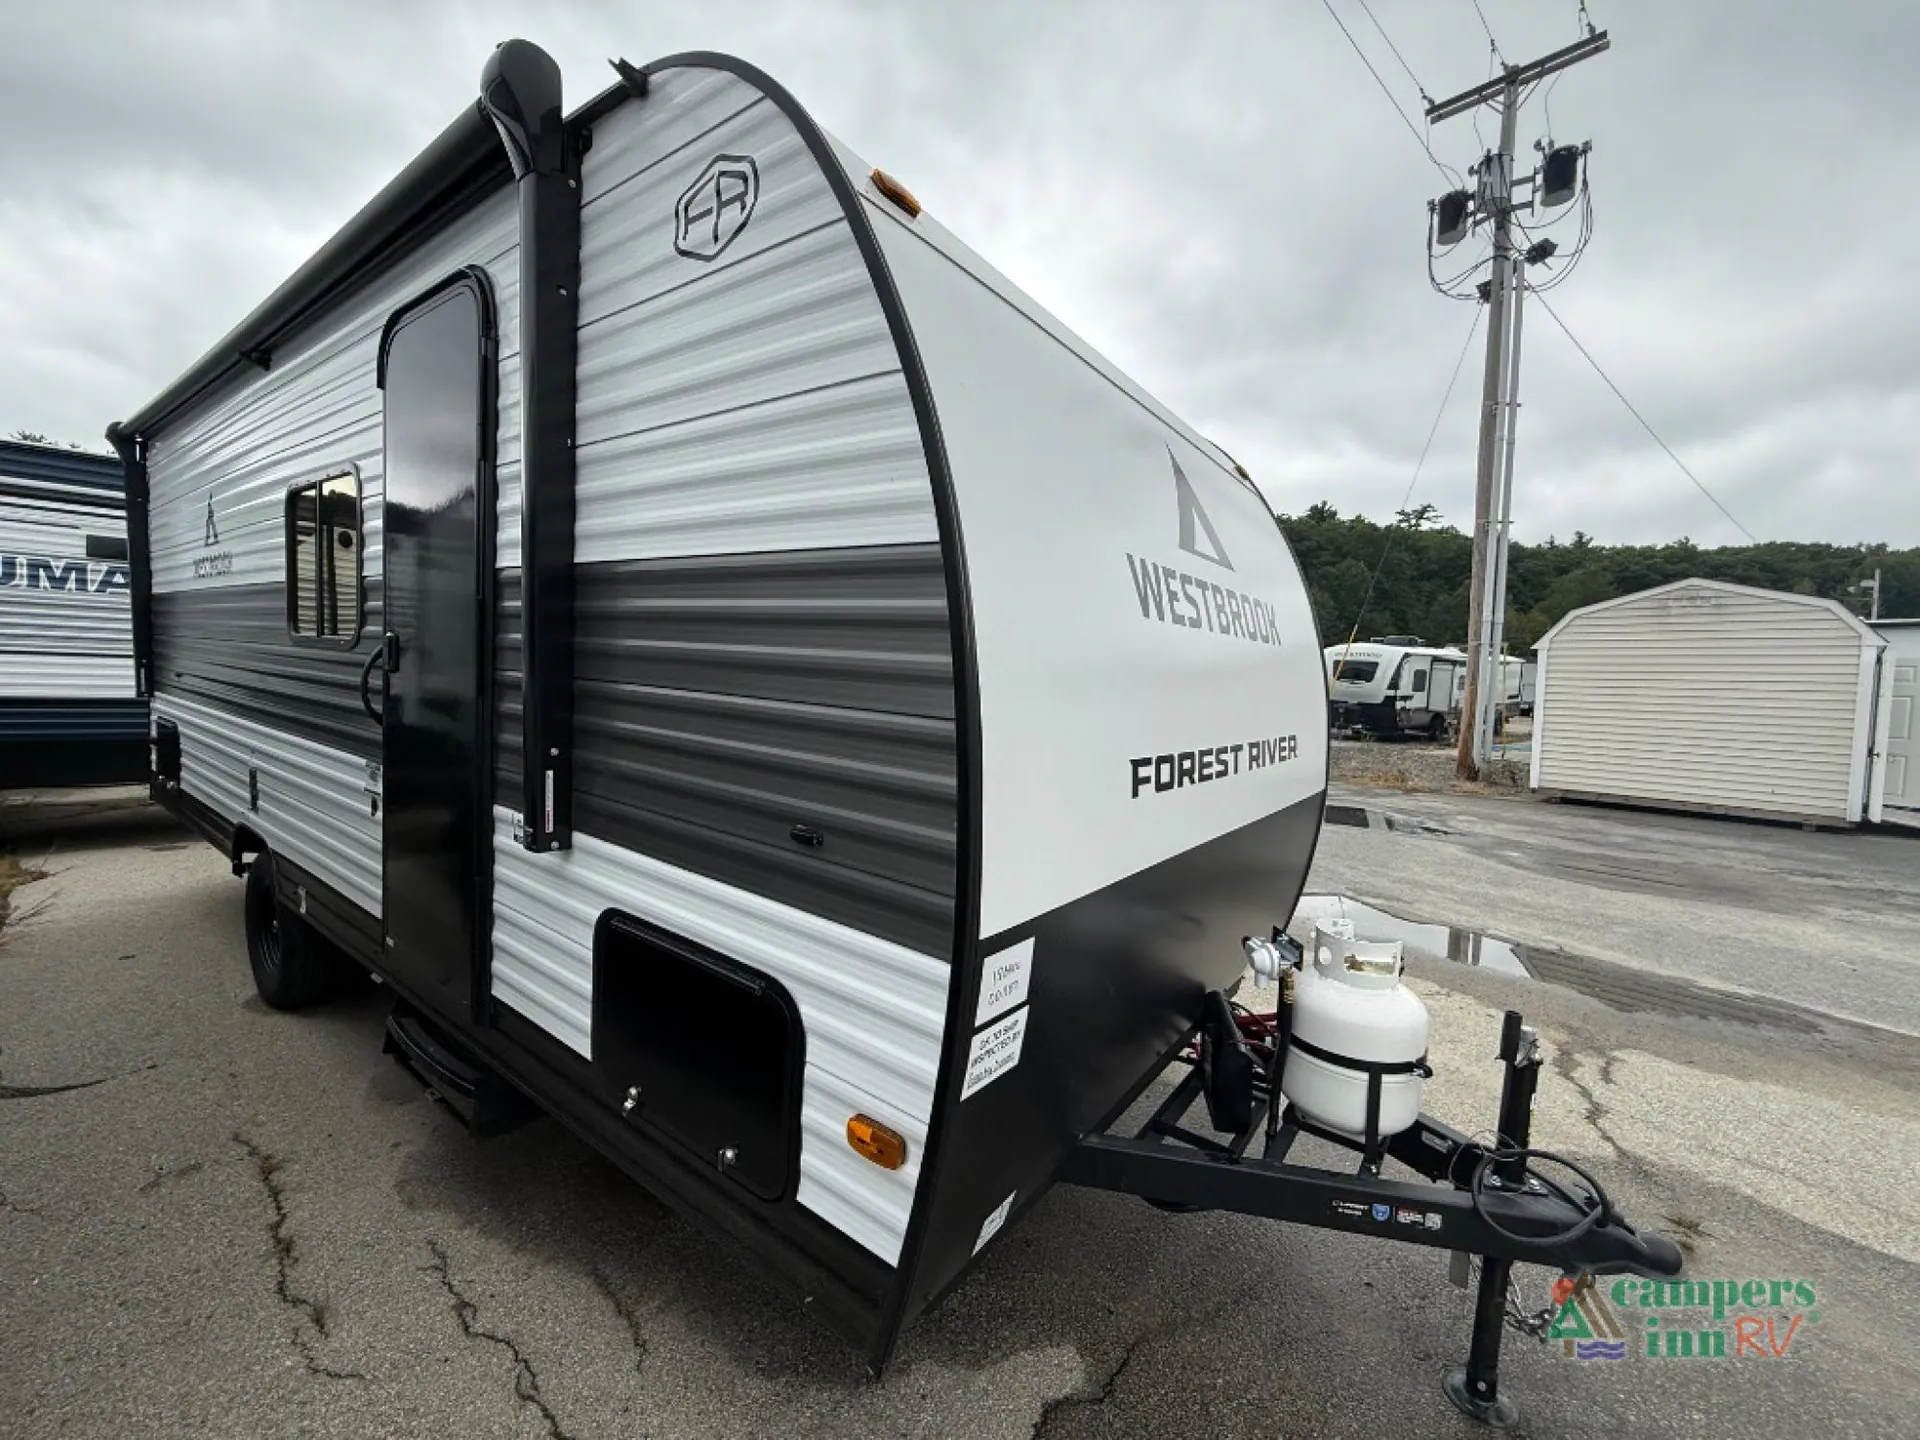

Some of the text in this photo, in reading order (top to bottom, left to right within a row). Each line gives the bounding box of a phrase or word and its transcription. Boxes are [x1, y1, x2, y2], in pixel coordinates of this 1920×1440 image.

[1125, 552, 1281, 646] WESTBROOK
[1129, 734, 1299, 799] FOREST RIVER
